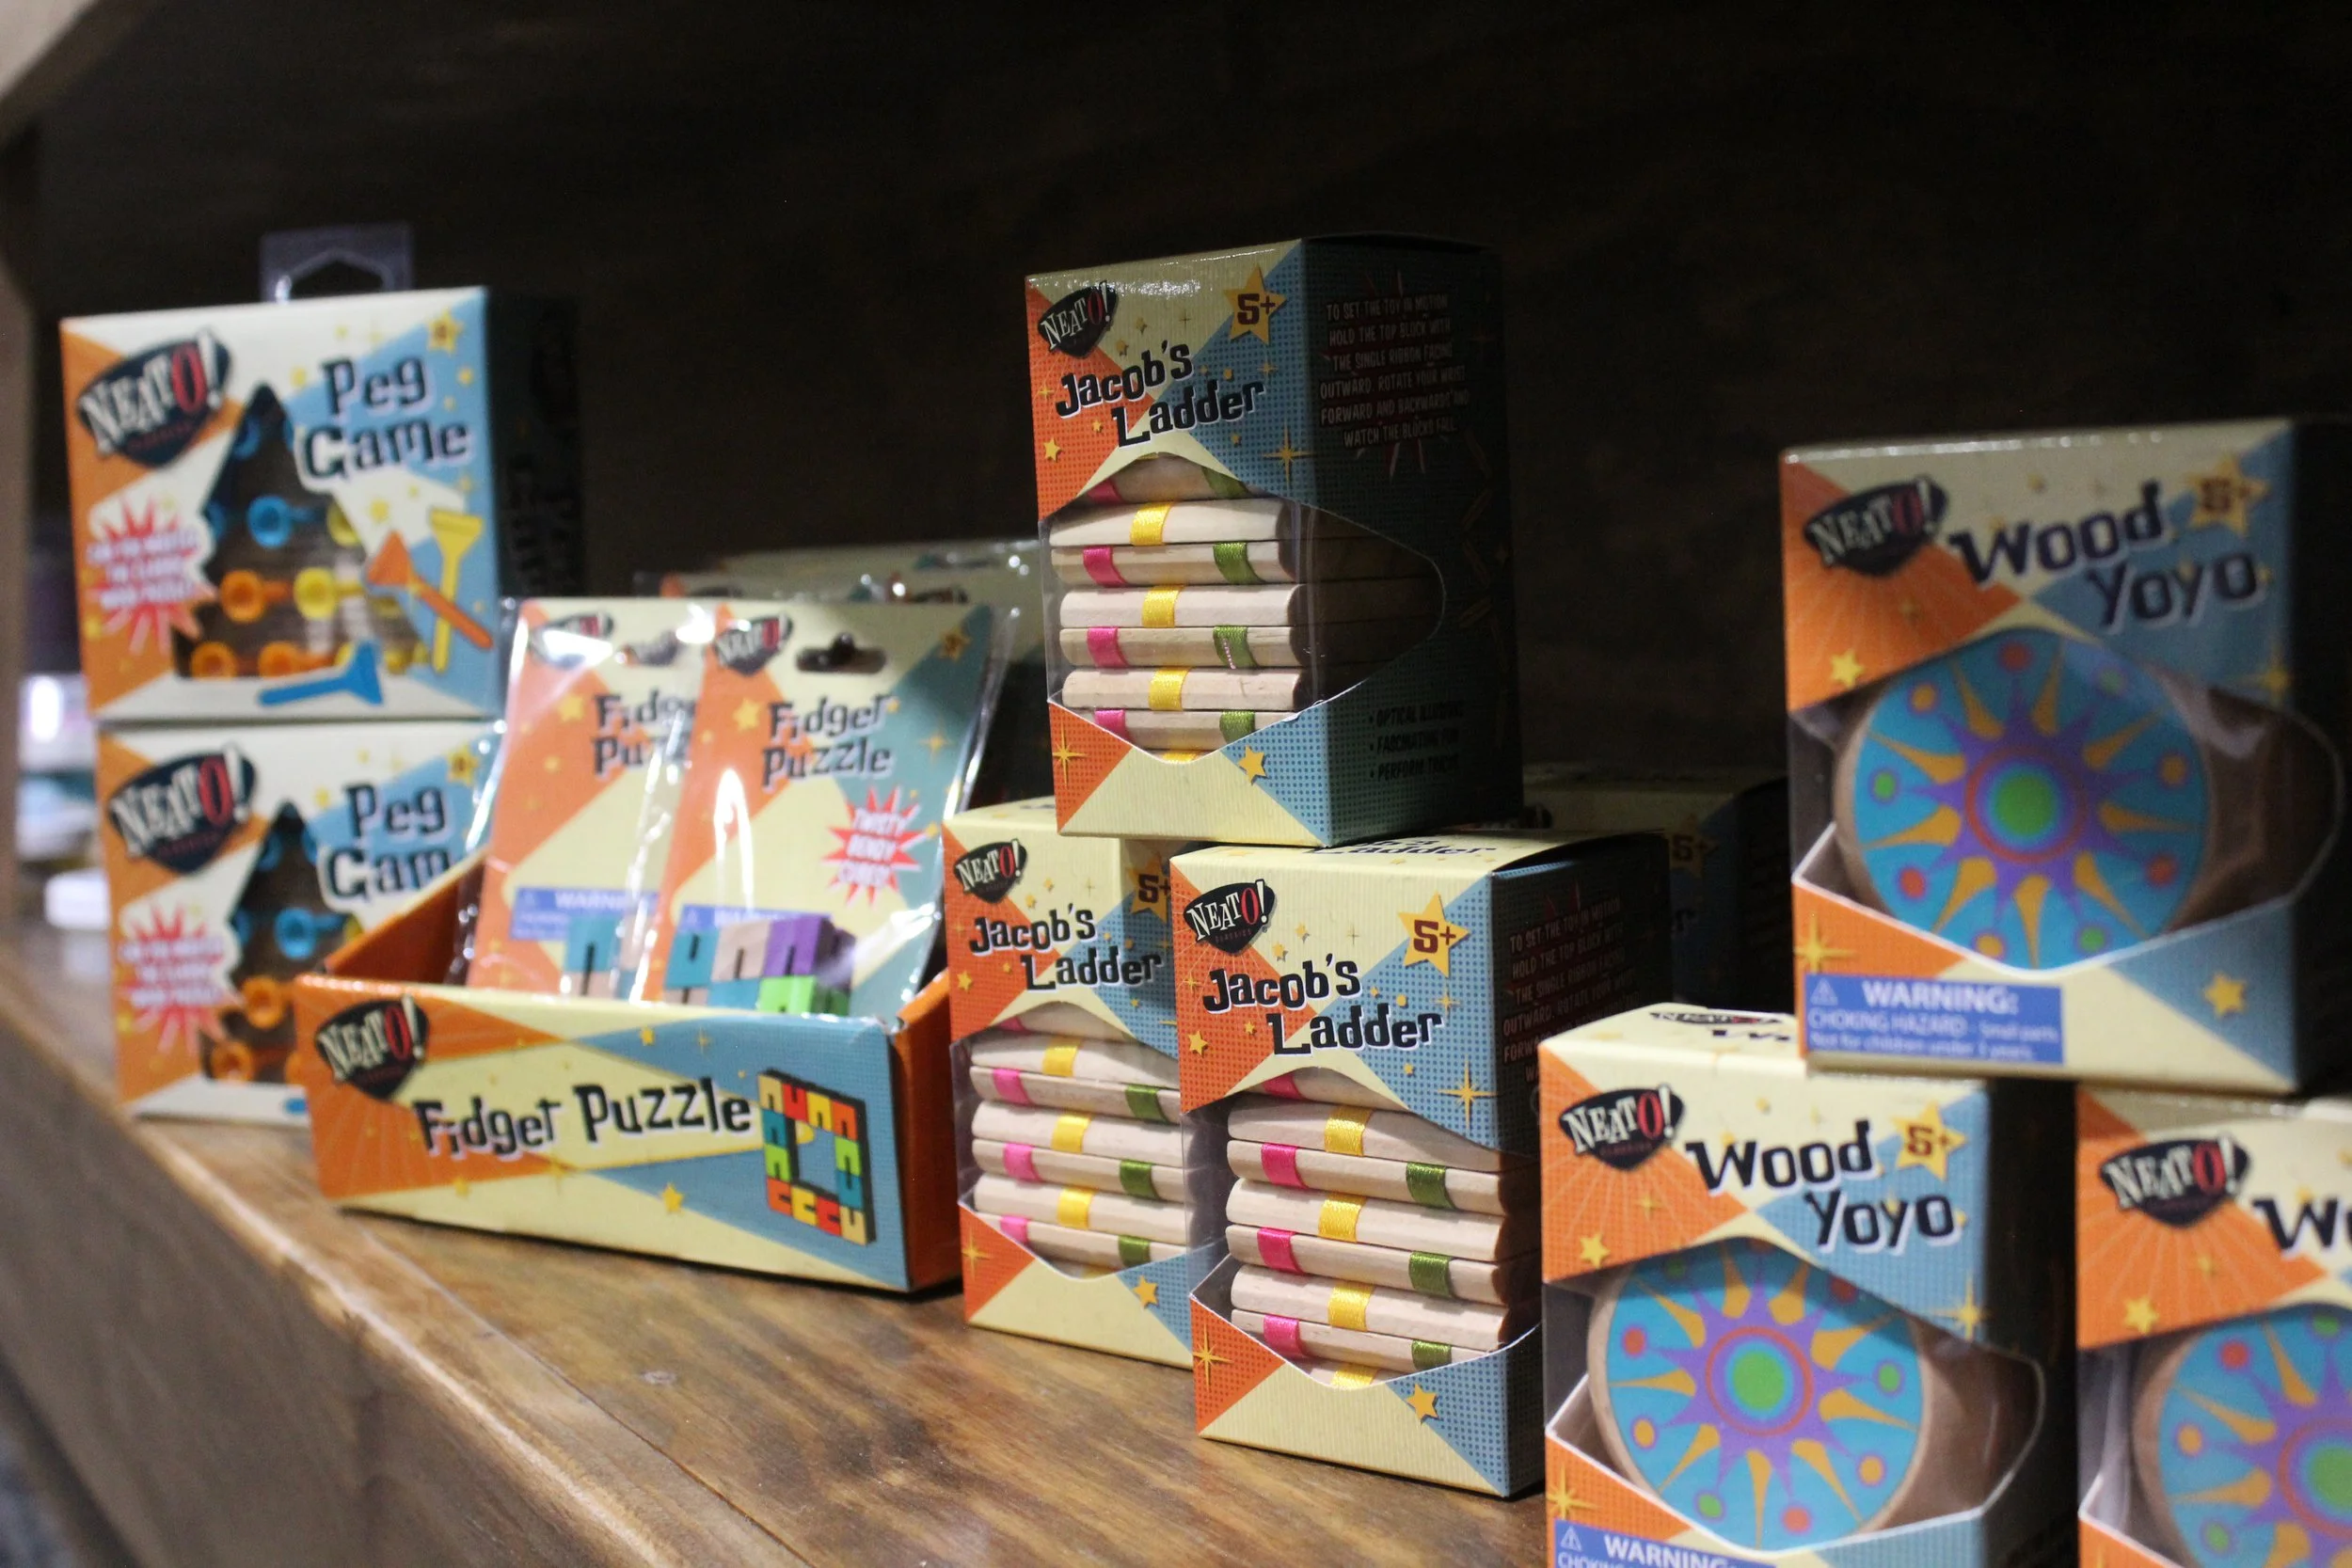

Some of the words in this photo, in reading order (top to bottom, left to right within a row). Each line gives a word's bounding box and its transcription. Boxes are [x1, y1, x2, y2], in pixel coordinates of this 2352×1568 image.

[1040, 281, 1111, 350] NEATO!
[1236, 293, 1276, 325] 5+
[1327, 304, 1340, 321] TO
[1343, 301, 1360, 320] SET
[1364, 300, 1381, 317] THE
[1328, 327, 1355, 346] HOLD
[1359, 325, 1376, 343] THE
[1379, 324, 1397, 341] TOP
[323, 356, 426, 416] Peg
[1056, 340, 1193, 417] Jacob's
[1332, 354, 1351, 372] THE
[1355, 350, 1386, 369] SINGLE
[1378, 372, 1413, 392] ROTATE
[79, 329, 222, 451] NEATO!
[1111, 379, 1264, 448] Ladder
[1320, 403, 1373, 425] FORWARD
[1376, 399, 1394, 417] AND
[302, 419, 469, 478] Game
[1343, 428, 1379, 449] WATCH
[1383, 424, 1401, 441] THE
[1809, 477, 1933, 565] NEATO!
[1947, 480, 2162, 583] Wood
[2087, 551, 2258, 627] Yoyo
[594, 689, 695, 728] Fidg
[768, 692, 894, 739] Fidget
[763, 737, 892, 787] Puzzle
[110, 743, 251, 857] NEATO!
[345, 784, 447, 837] Peg
[328, 848, 453, 902] Gam
[956, 839, 1022, 891] NEATO!
[969, 903, 1096, 954] Jacob's
[1186, 879, 1267, 941] NEATO!
[1413, 919, 1456, 953] 5+
[1020, 945, 1162, 990] Ladder
[1510, 935, 1522, 954] TO
[1512, 958, 1537, 980] HOLD
[1202, 953, 1361, 1012] Jacob's
[1515, 985, 1534, 1006] THE
[1861, 979, 2019, 1016] WARNING:
[318, 994, 424, 1082] NEATO!
[1266, 1003, 1442, 1054] Ladder
[414, 1097, 561, 1157] Fidget
[575, 1077, 752, 1142] Puzzle
[1562, 1084, 1674, 1153] NEATO!
[1905, 1124, 1951, 1156] 5+
[1685, 1118, 1875, 1191] Wood
[2102, 1132, 2240, 1210] NEATO!
[1804, 1189, 1956, 1247] Yoyo
[2251, 1196, 2352, 1251] W
[1602, 1534, 1737, 1568] WARNIN
